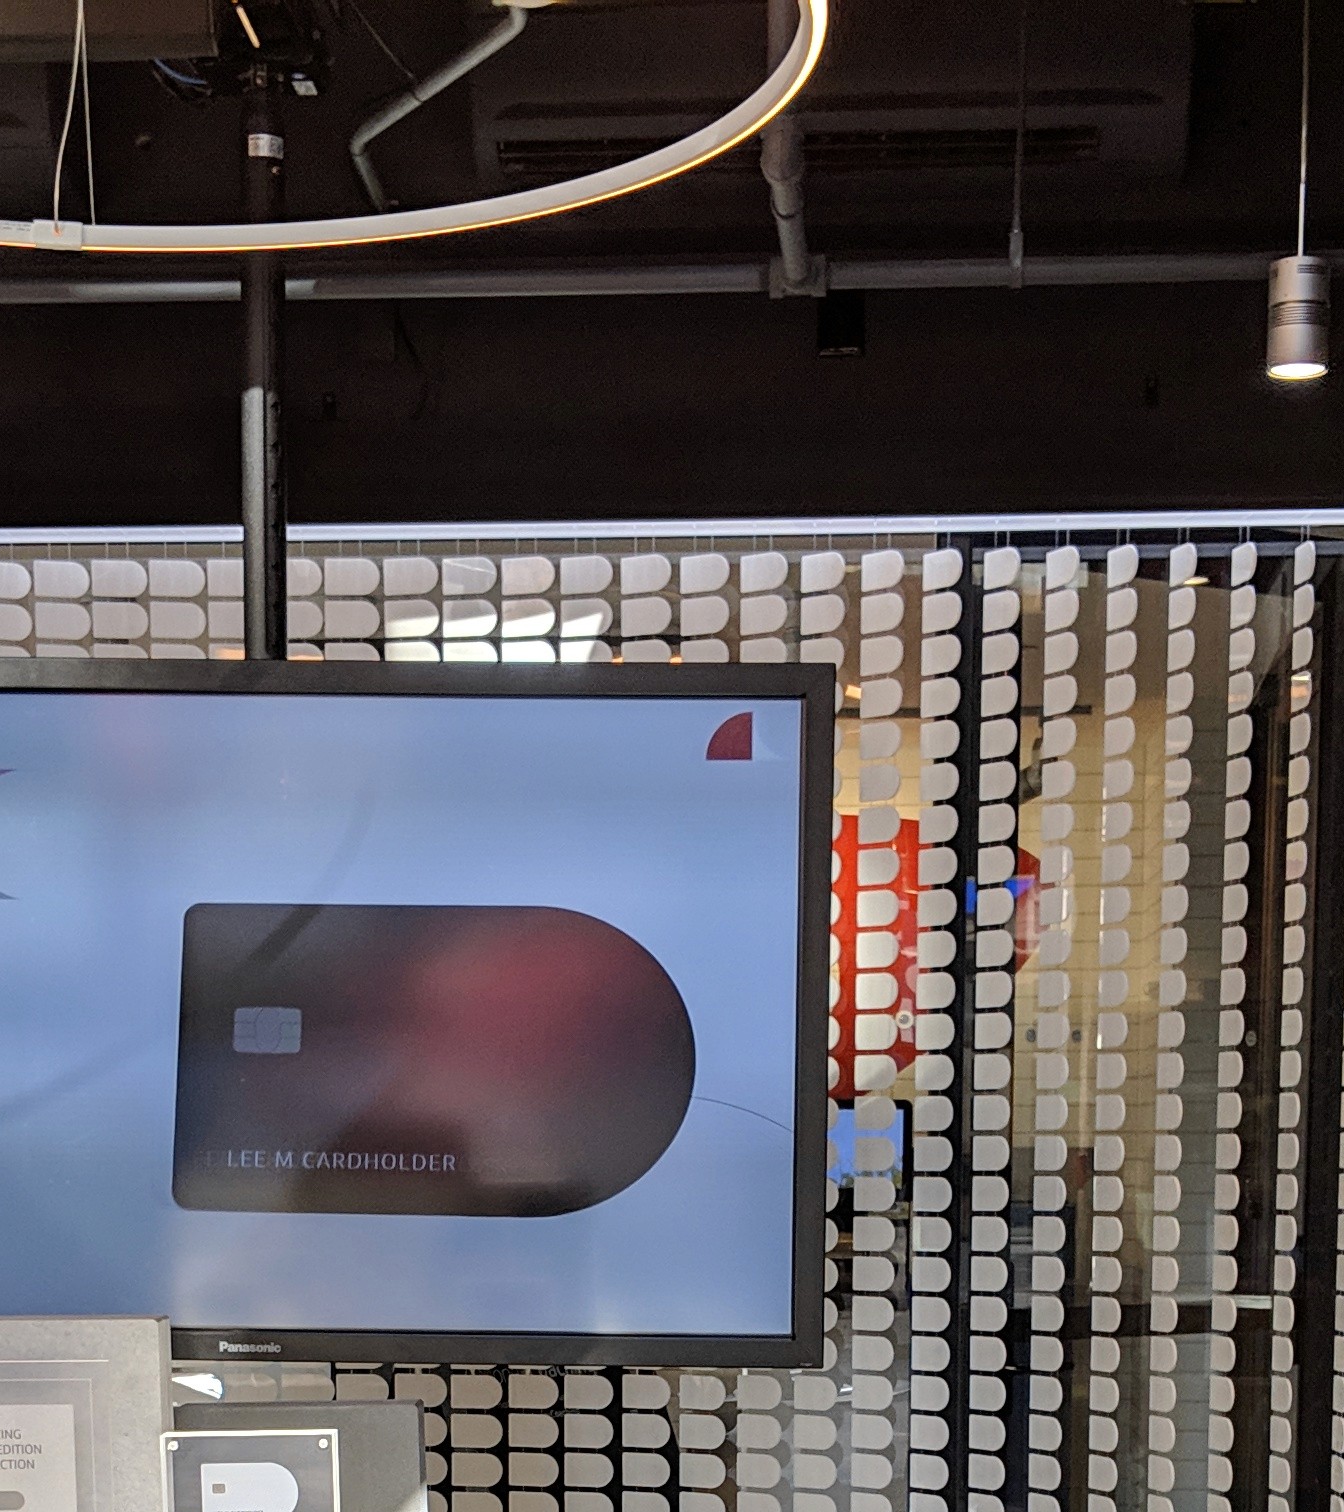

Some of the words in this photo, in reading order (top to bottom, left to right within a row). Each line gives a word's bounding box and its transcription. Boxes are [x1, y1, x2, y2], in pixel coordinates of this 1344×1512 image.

[227, 1150, 266, 1168] LEE
[275, 1150, 294, 1169] M
[302, 1151, 457, 1172] CARDHOLDER
[219, 1340, 282, 1353] Panasonic
